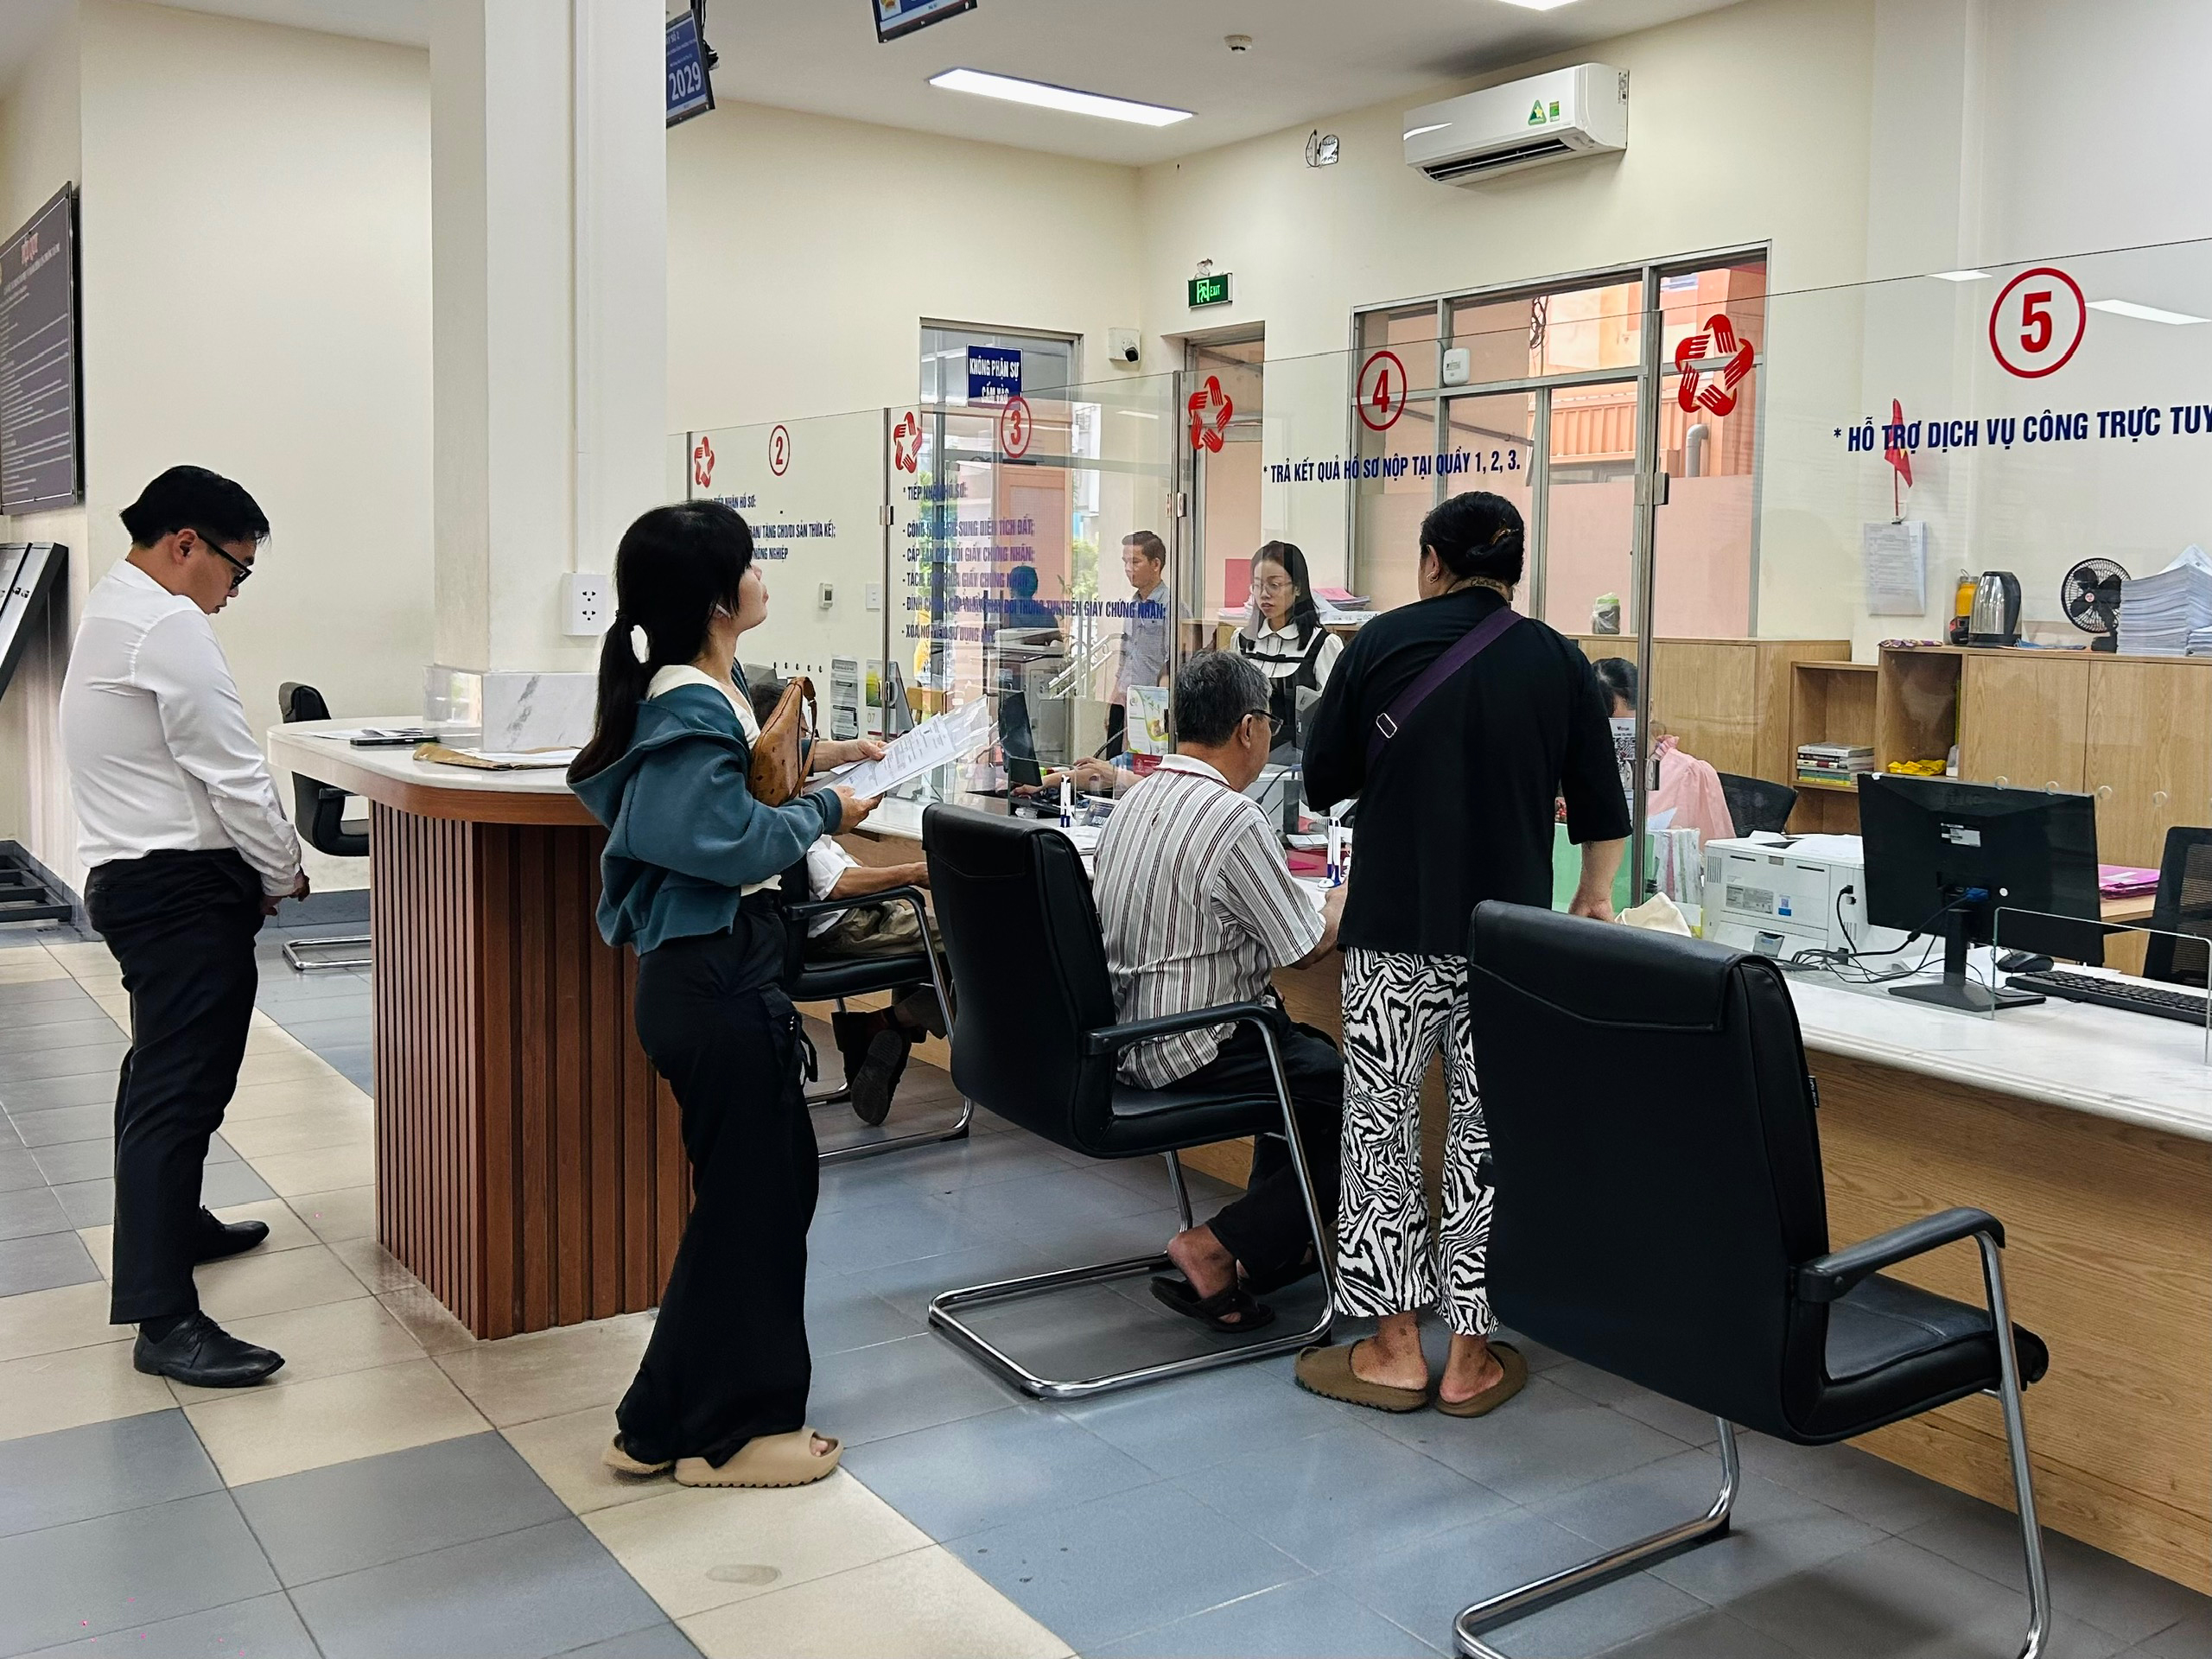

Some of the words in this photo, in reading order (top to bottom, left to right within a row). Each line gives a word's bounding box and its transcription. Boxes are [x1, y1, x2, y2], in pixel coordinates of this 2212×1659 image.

[669, 61, 702, 101] 2029
[1210, 284, 1221, 297] EXIT
[2019, 290, 2053, 353] 5
[969, 355, 990, 377] KHÔNG
[991, 357, 1009, 380] PHẬN
[1010, 361, 1020, 382] SỰ
[1372, 369, 1390, 414] 4
[1010, 410, 1021, 446] 3
[1847, 416, 1875, 452] HỖ
[1881, 420, 1923, 454] TRỢ
[1928, 420, 1979, 453] DỊCH
[1986, 417, 2016, 450] VỤ
[2023, 409, 2088, 443] CÔNG
[2097, 405, 2161, 442] TRỰC
[775, 435, 784, 466] 2
[1271, 457, 1291, 483] TRẢ
[1294, 456, 1314, 481] KẾT
[1318, 454, 1341, 483] QUẢ
[1344, 452, 1359, 480] HỒ
[1363, 456, 1380, 479] SƠ
[1383, 453, 1408, 481] NỘP
[1412, 454, 1432, 480] TẠI
[1436, 445, 1471, 477] QUẦY
[907, 481, 922, 501] TIẾP
[796, 519, 808, 538] SẢN
[958, 520, 979, 537] SUNG
[980, 518, 997, 540] DIỆN
[999, 516, 1015, 537] TÍCH
[769, 543, 789, 563] NGHIỆP
[907, 543, 920, 562] CẤP
[964, 541, 981, 562] GIẤY
[1061, 597, 1082, 617] TRÊN
[1084, 595, 1103, 617] GIẤY
[1105, 598, 1135, 618] CHỨNG
[867, 712, 876, 724] 07
